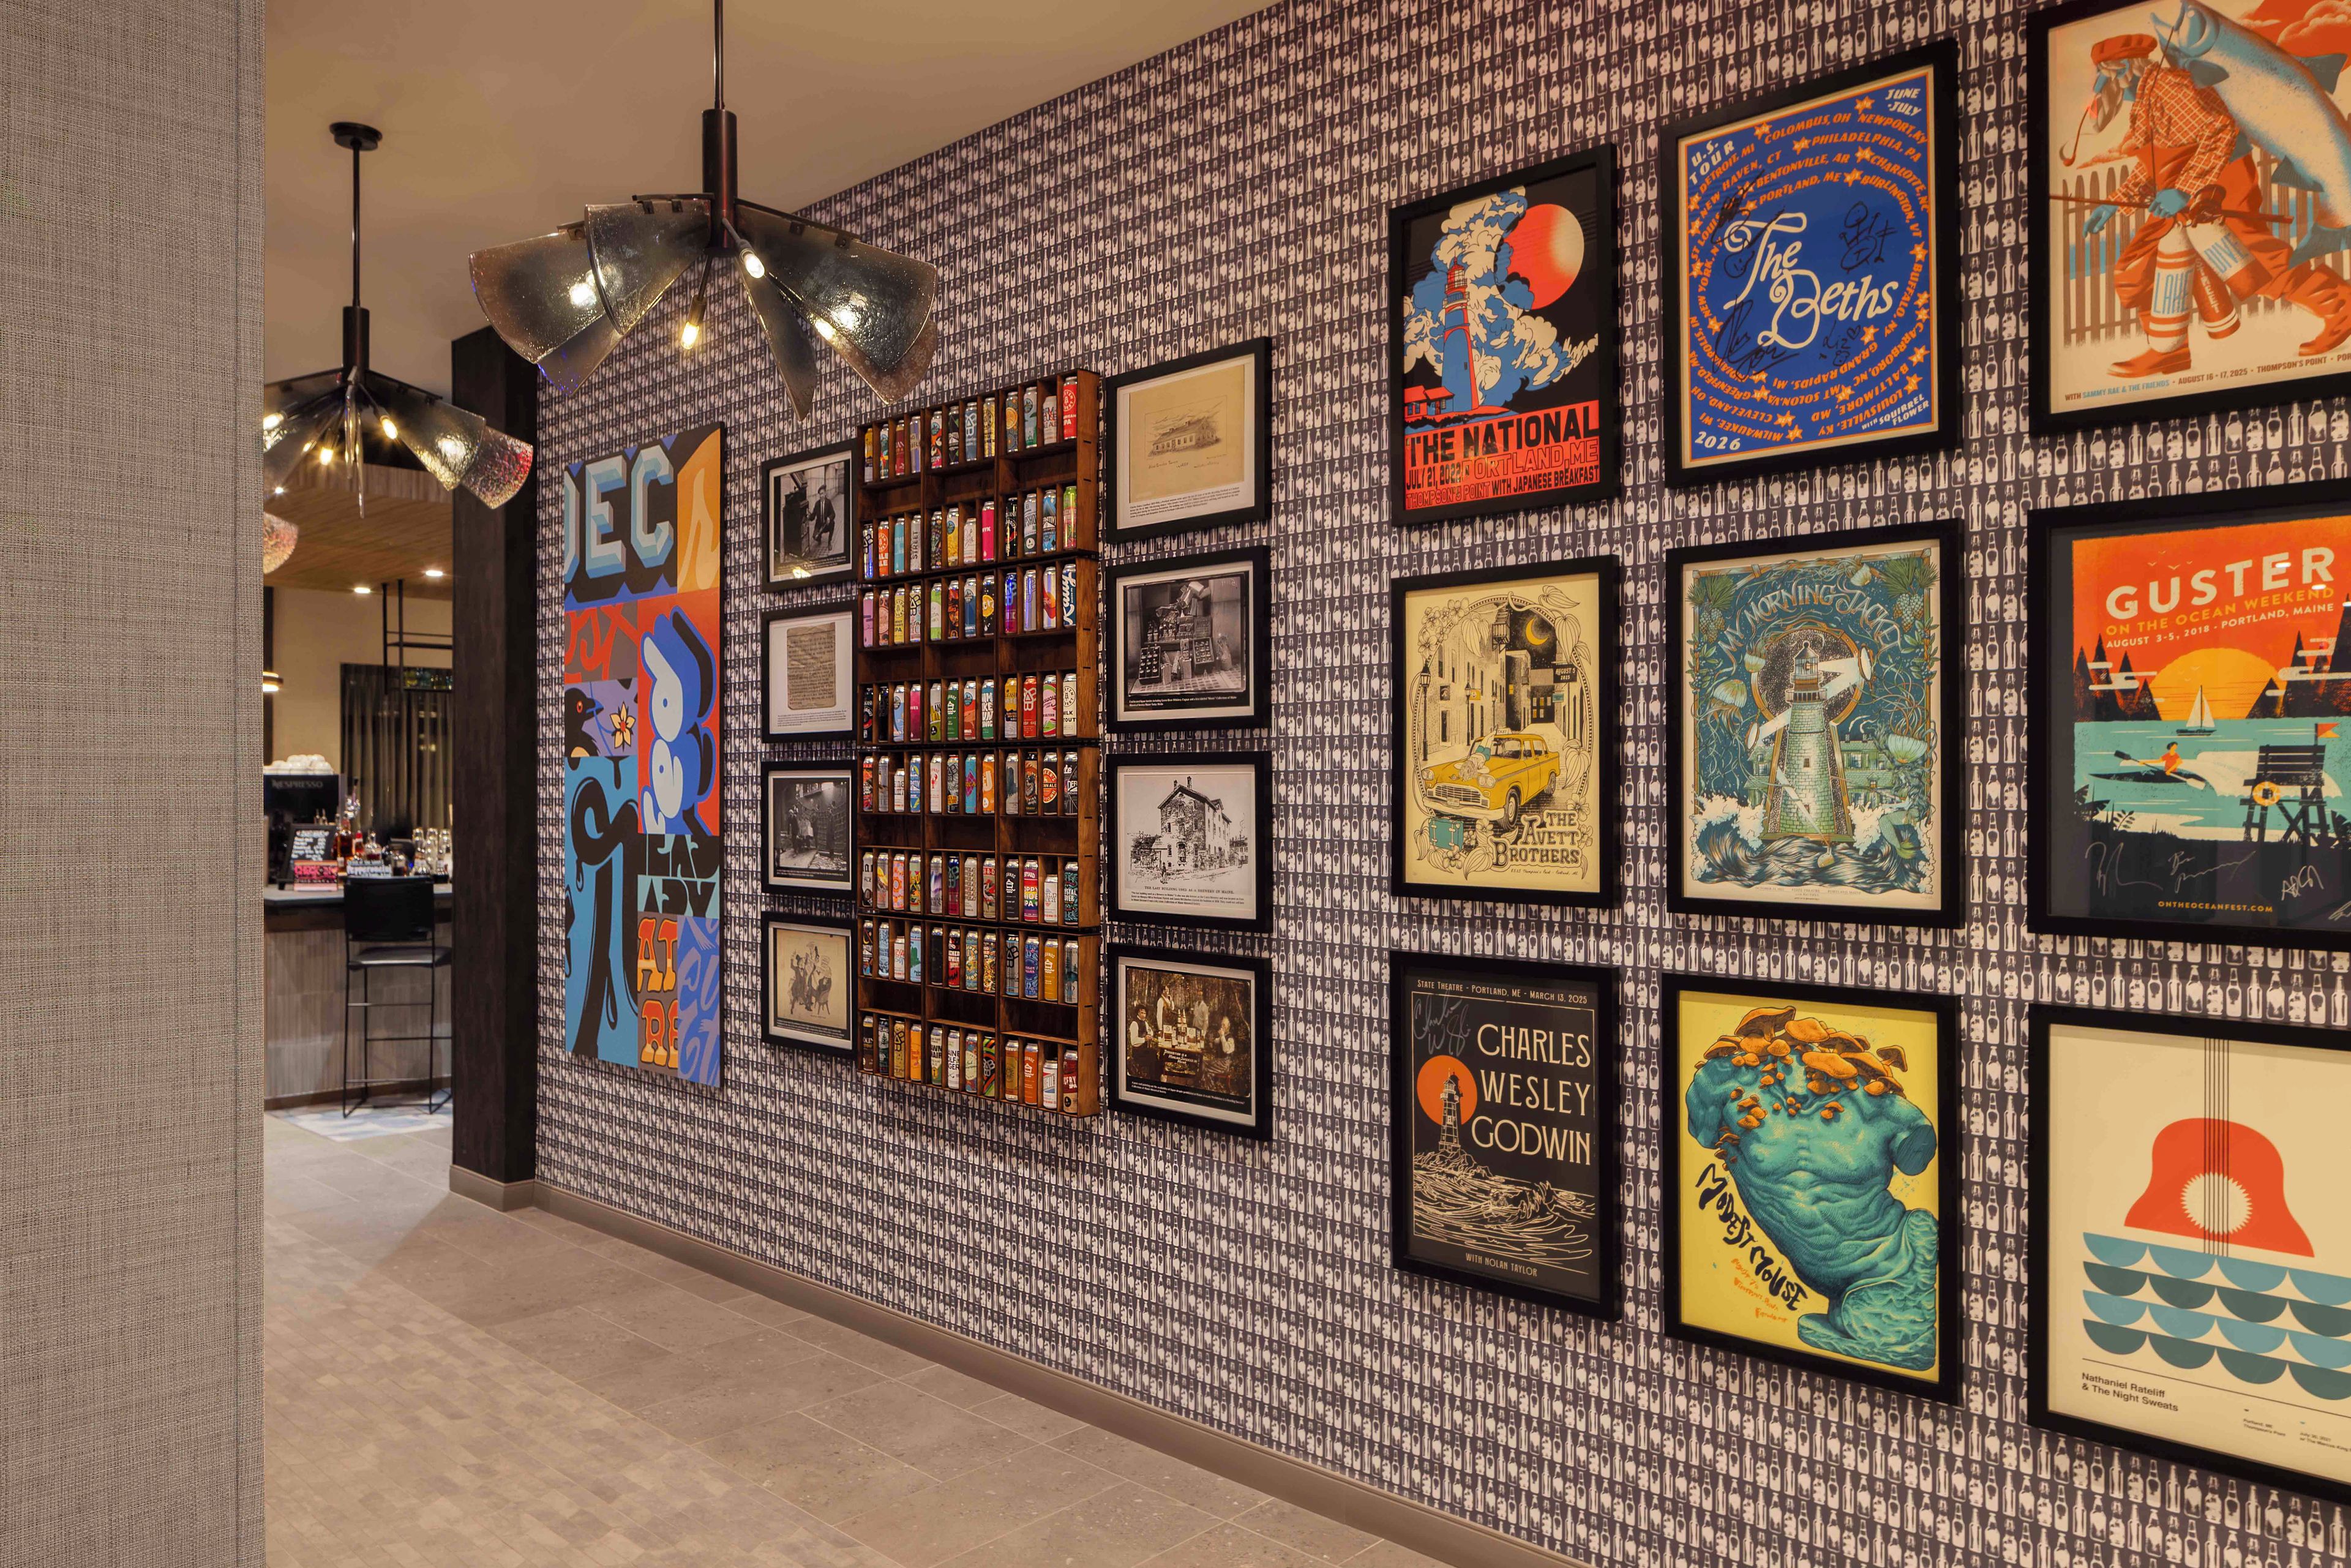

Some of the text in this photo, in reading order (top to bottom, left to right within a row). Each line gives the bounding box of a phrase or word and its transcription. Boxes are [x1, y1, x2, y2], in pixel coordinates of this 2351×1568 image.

[1884, 88, 1921, 100] JUNE
[1832, 113, 1852, 124] OH
[1689, 140, 1735, 185] TOUR
[1691, 140, 1719, 167] U.S.
[1741, 143, 1755, 157] MI
[1832, 152, 1851, 164] AR
[1904, 146, 1922, 163] PA
[1700, 191, 1722, 219] NEW
[1766, 149, 1782, 165] CT
[1823, 170, 1842, 182] ME
[1909, 222, 1923, 238] VT
[1723, 212, 1807, 311] The
[1697, 296, 1712, 319] NEW
[1757, 268, 1899, 348] Beths
[1689, 315, 1701, 328] IN
[1884, 319, 1899, 339] NY
[1839, 341, 1878, 375] GRAND
[1772, 376, 1789, 390] MI
[1853, 370, 1869, 387] NC
[2064, 392, 2082, 402] WITH
[2082, 388, 2107, 399] SAMMY
[2107, 386, 2120, 396] RAE
[2121, 384, 2127, 393] &
[2128, 382, 2141, 392] THE
[2142, 378, 2170, 391] FRIENDS
[2178, 374, 2205, 386] AUGUST
[2206, 372, 2214, 381] 16
[2230, 367, 2248, 378] 2025
[2257, 359, 2304, 374] THOMPSON'S
[2305, 356, 2328, 367] POINT
[1690, 385, 1707, 401] OH
[1698, 411, 1714, 426] WI
[1810, 408, 1832, 422] MD
[1861, 393, 1925, 430] WITH SQUIRREL
[1892, 400, 1930, 426] FLOWER
[1406, 406, 1599, 467] THE NATIONAL
[1694, 430, 1741, 451] 2026
[1818, 424, 1834, 437] KY
[1406, 462, 1461, 490] JULY 21, 2022
[1463, 482, 1491, 500] POINT
[1491, 478, 1512, 496] WITH
[1513, 471, 1552, 492] JAPANESE
[1554, 465, 1599, 487] BREAKFAST
[2105, 546, 2335, 620] GUSTER
[1744, 579, 1842, 640] MORNING
[2106, 587, 2334, 637] ON THE OCEAN WEEKEND
[2106, 602, 2334, 648] AUGUST 3-5, 2018 PORTLAND, MAINE
[271, 779, 323, 789] NESPRESSO
[1520, 816, 1580, 846] AVETT
[1546, 811, 1577, 827] THE
[1489, 837, 1580, 867] BROTHERS
[2157, 900, 2273, 913] ONTHEOCEANFEST.COM
[1512, 988, 1521, 998] ME
[1568, 994, 1588, 1005] 2025
[1477, 1023, 1591, 1068] CHARLES
[1480, 1069, 1591, 1116] WESLEY
[1471, 1115, 1591, 1166] GODWIN
[1695, 1163, 1758, 1249] MODEST
[1750, 1246, 1809, 1311] MOUSE
[1466, 1251, 1538, 1277] WITH NOLAN TAYLOR
[2082, 1371, 2165, 1398] Nathaniel Rateliff
[2082, 1382, 2178, 1412] & The Night Sweats
